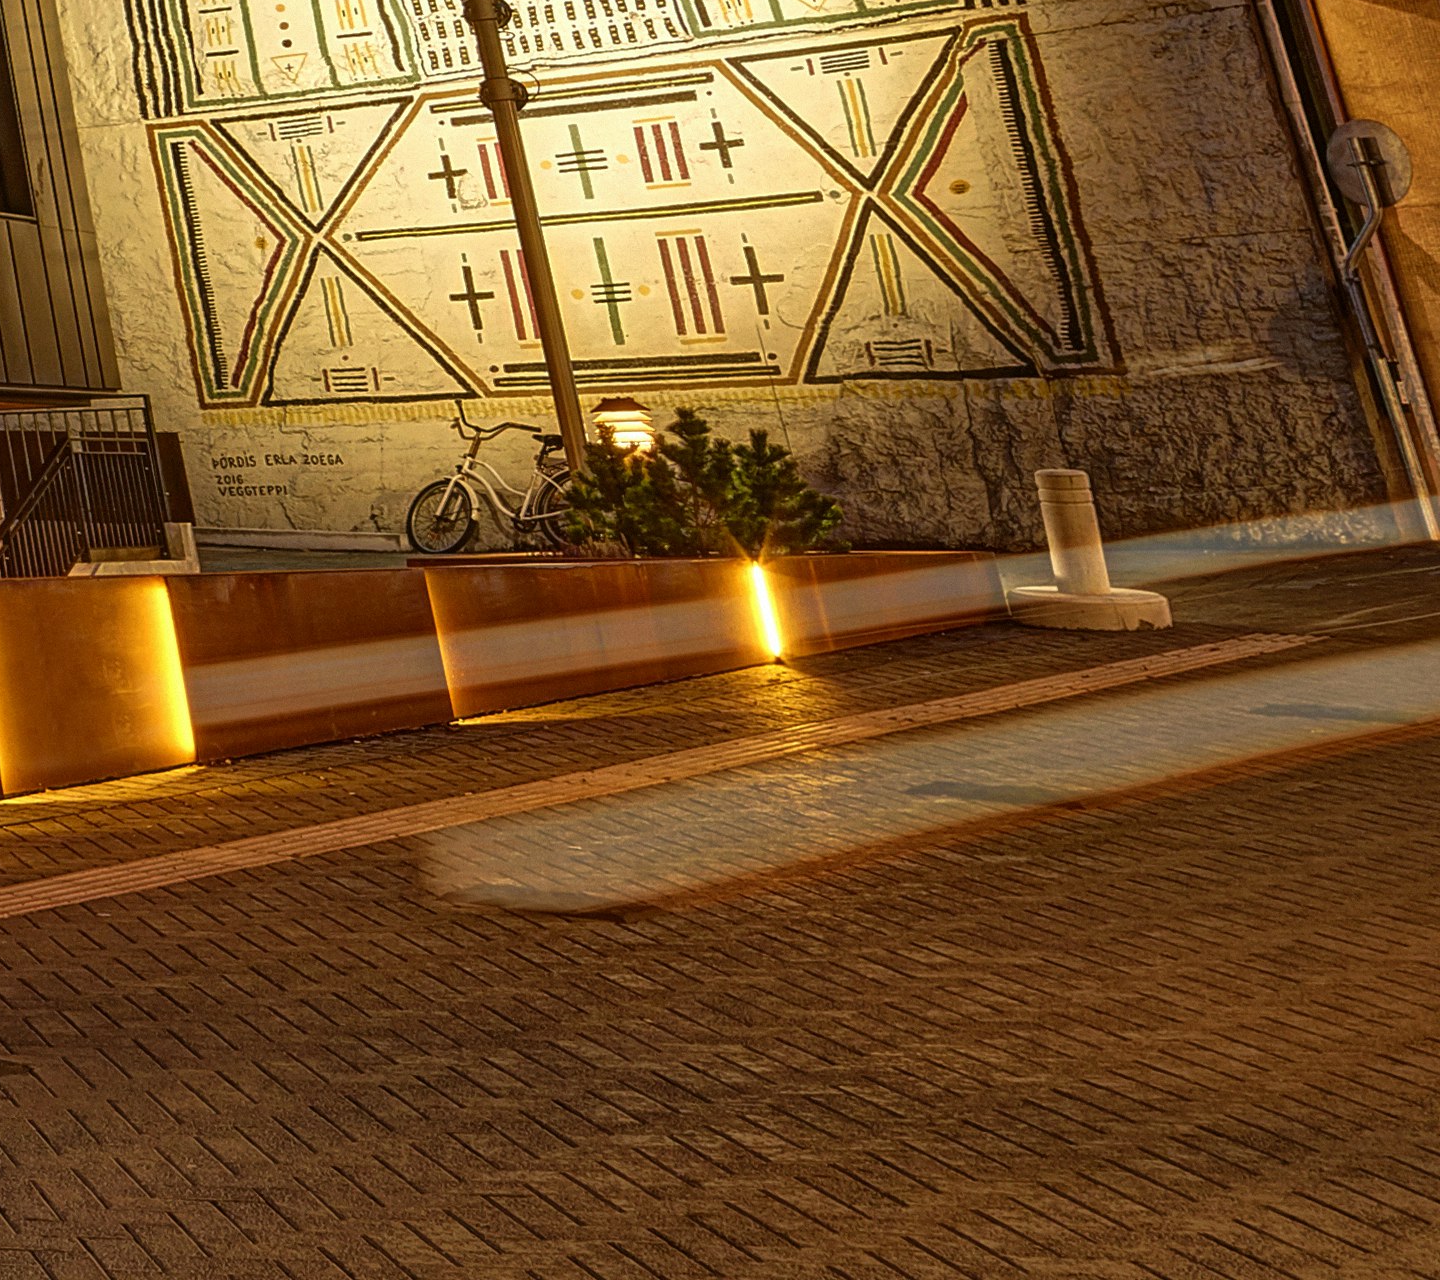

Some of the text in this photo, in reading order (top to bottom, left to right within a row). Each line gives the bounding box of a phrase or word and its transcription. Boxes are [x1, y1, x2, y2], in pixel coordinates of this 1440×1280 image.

[265, 453, 298, 466] ERLA
[215, 474, 244, 486] 2016
[217, 485, 289, 497] VEGGTEPPI
